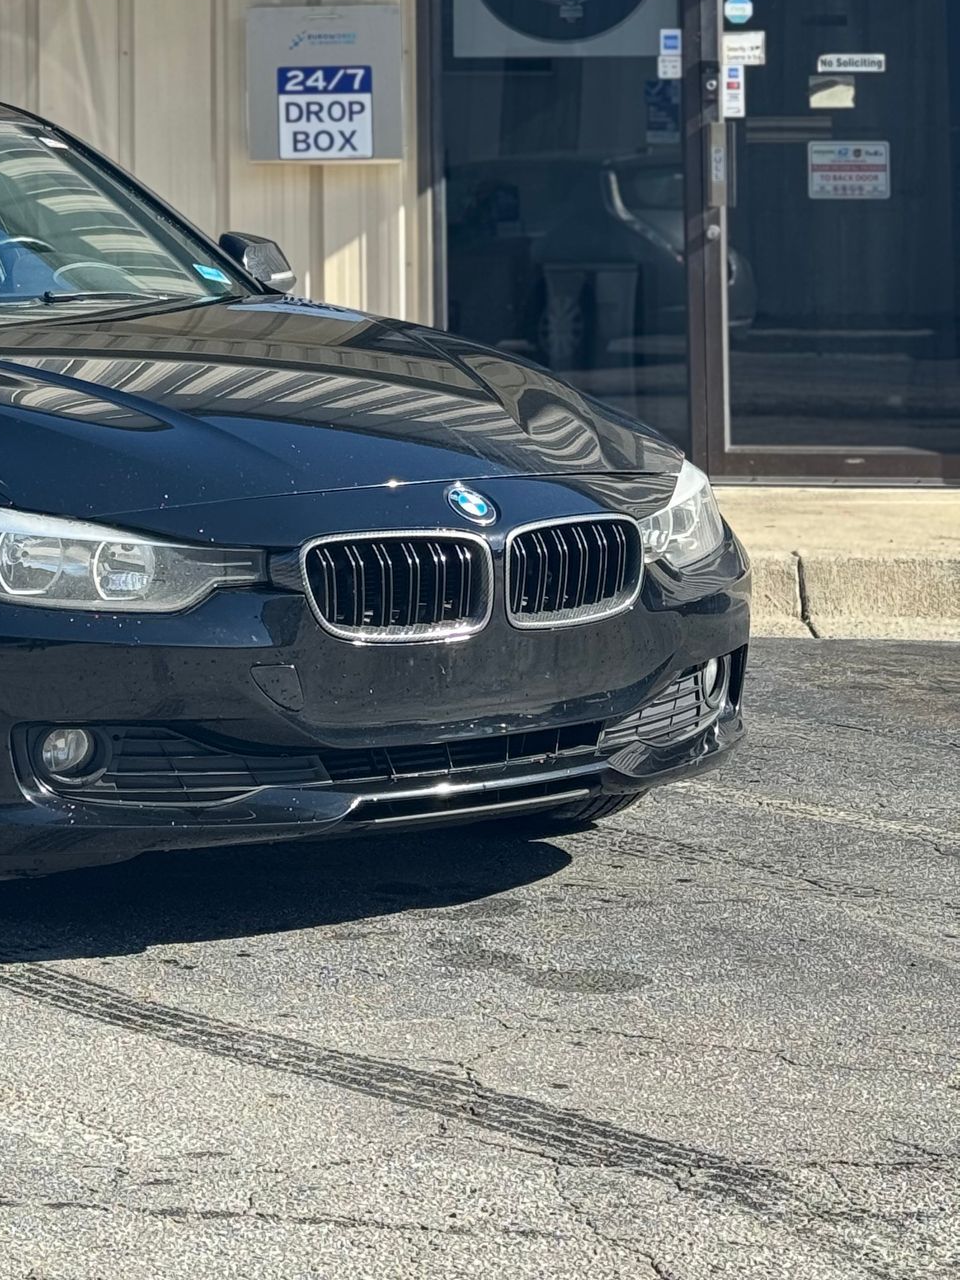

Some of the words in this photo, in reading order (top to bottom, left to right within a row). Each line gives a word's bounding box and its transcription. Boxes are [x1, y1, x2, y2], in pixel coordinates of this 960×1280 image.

[820, 58, 833, 68] No
[836, 57, 883, 70] Soliciting
[284, 68, 365, 92] 24/7
[284, 100, 366, 124] DROP
[292, 130, 358, 153] BOX
